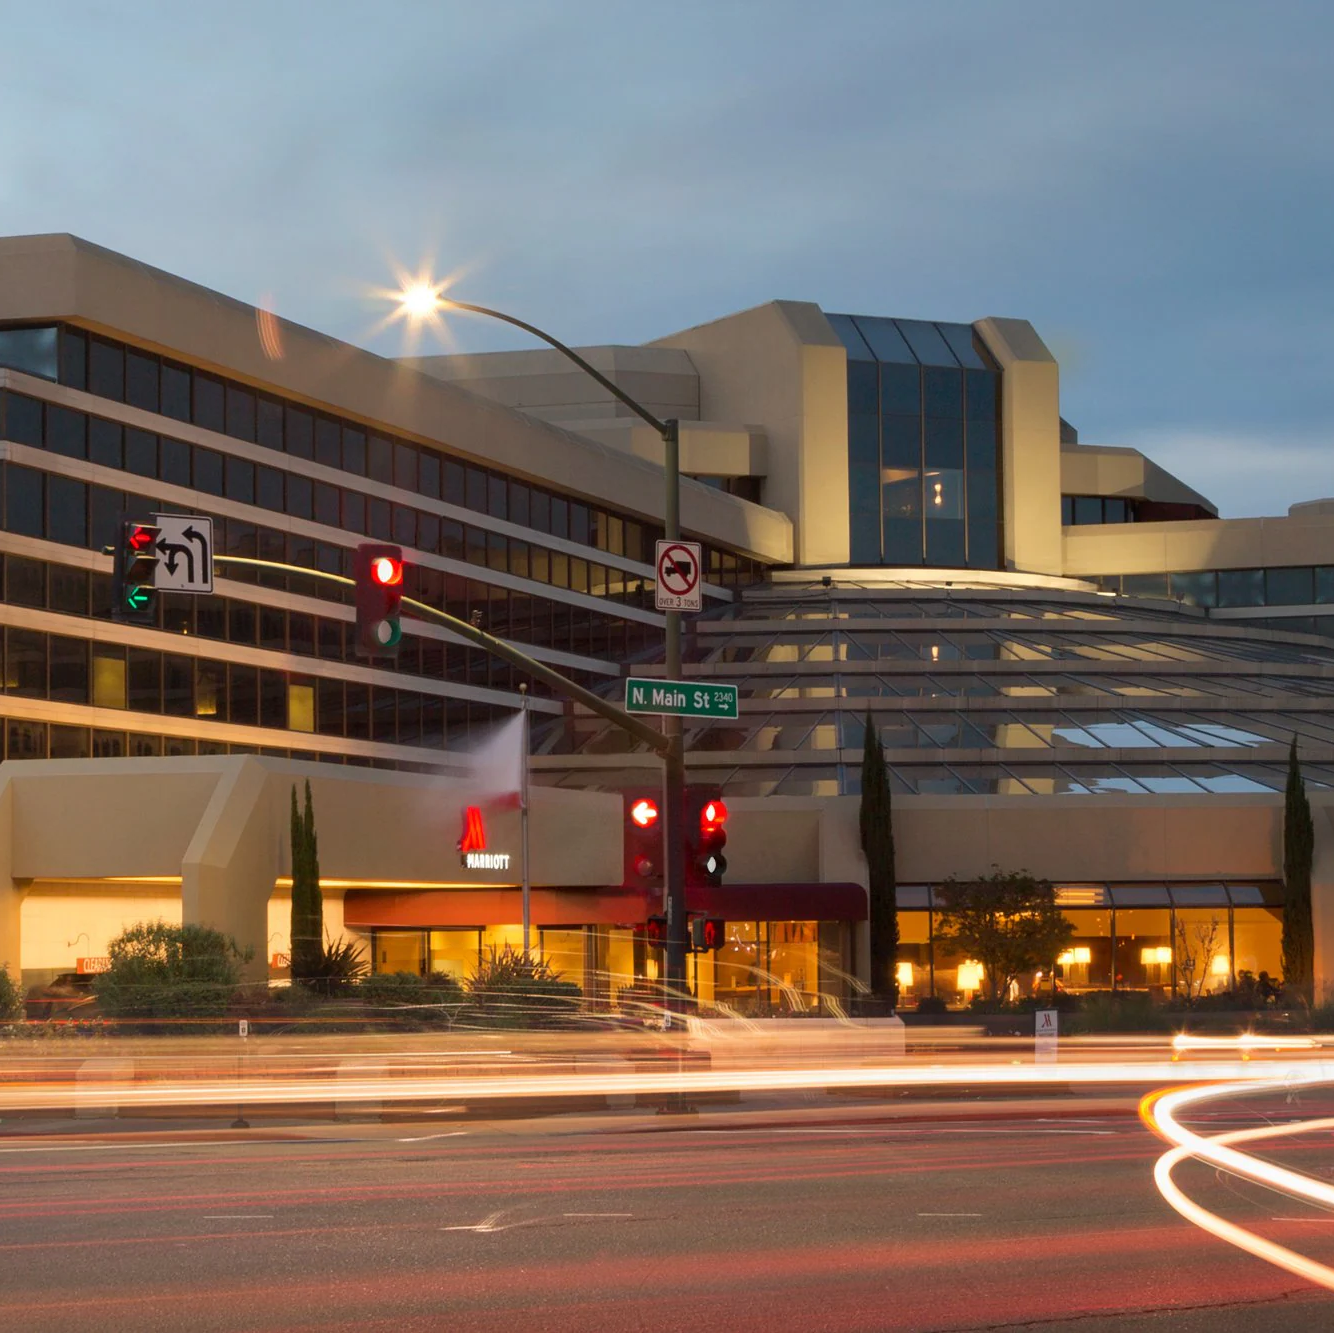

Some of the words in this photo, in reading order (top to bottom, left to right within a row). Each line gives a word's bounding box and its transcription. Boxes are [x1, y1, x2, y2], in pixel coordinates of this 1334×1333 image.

[659, 597, 674, 605] OVER
[676, 596, 682, 607] 3
[684, 598, 698, 608] TONS
[632, 687, 647, 705] N.
[652, 688, 686, 707] Main
[693, 691, 710, 709] St
[714, 691, 733, 703] 2340
[466, 853, 510, 870] MARRIOTT
